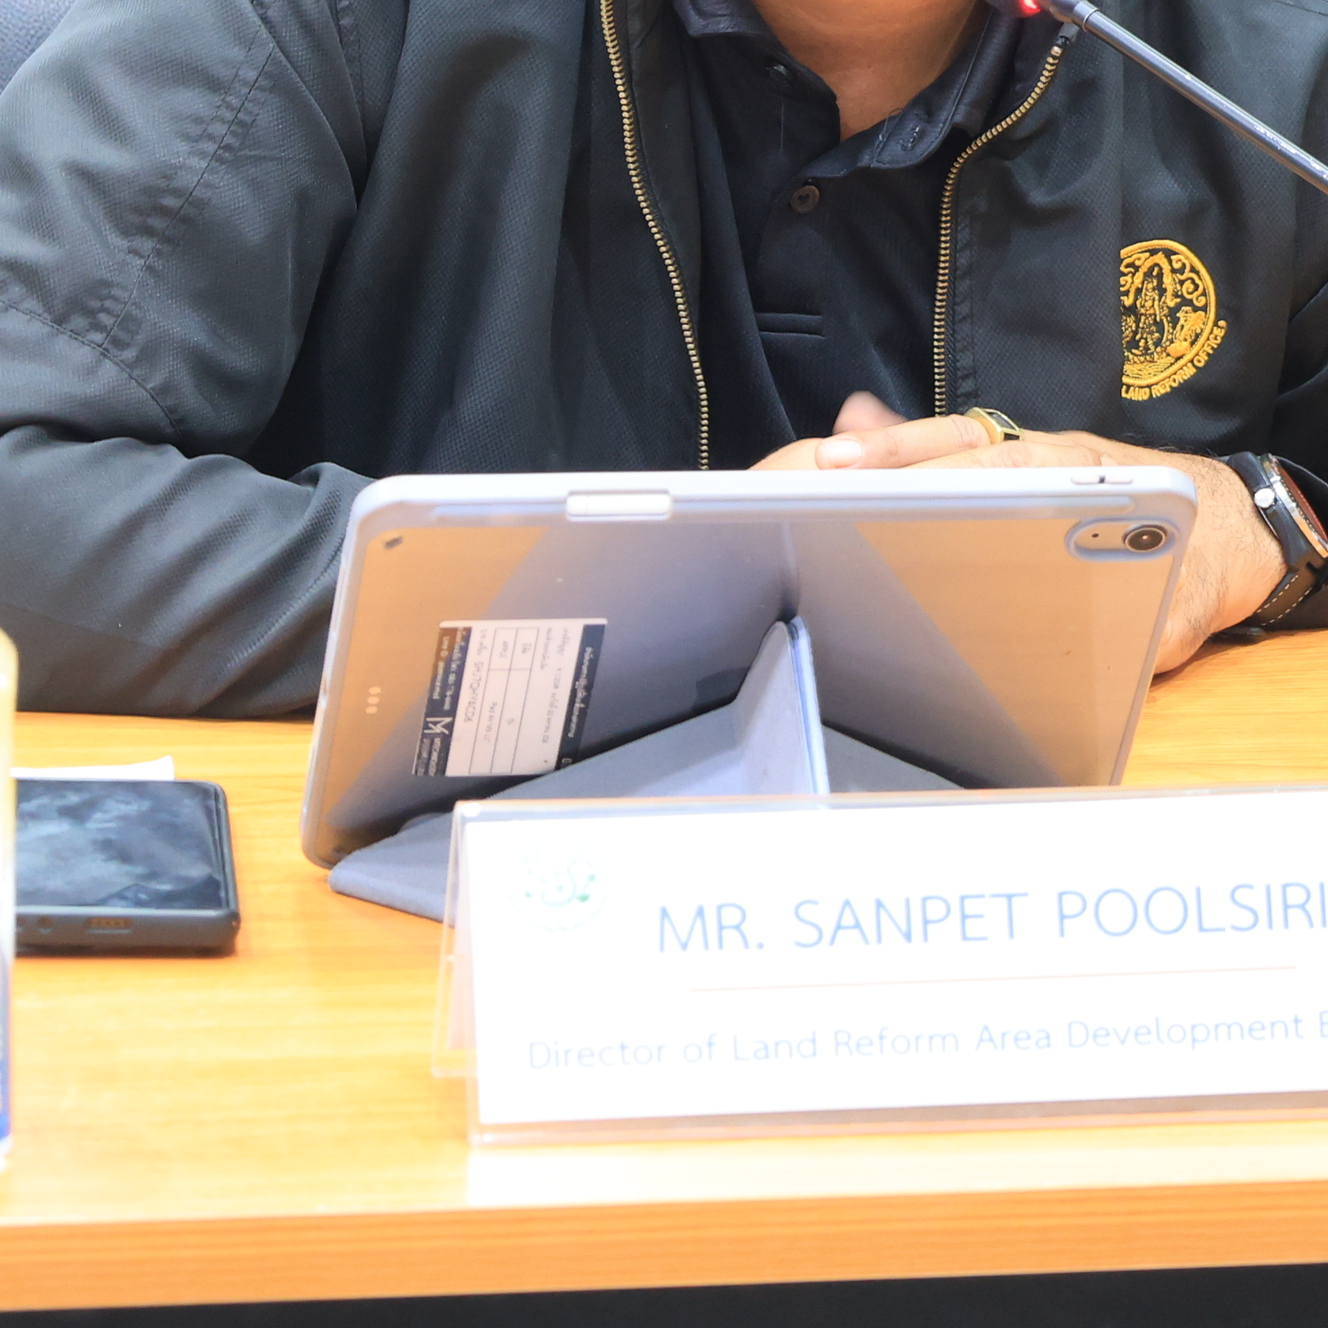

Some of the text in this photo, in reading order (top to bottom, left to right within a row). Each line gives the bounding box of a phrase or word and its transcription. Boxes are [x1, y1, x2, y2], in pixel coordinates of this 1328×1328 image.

[1121, 385, 1151, 402] LAND
[1151, 363, 1198, 399] REFORM
[657, 881, 1328, 953] MR. SANPET POOLSIRI
[528, 1038, 668, 1069] Director
[682, 1032, 718, 1063] of
[732, 1029, 818, 1062] Land
[833, 1026, 960, 1056] Reform
[974, 1024, 1053, 1051] Area
[1067, 1015, 1304, 1051] Development
